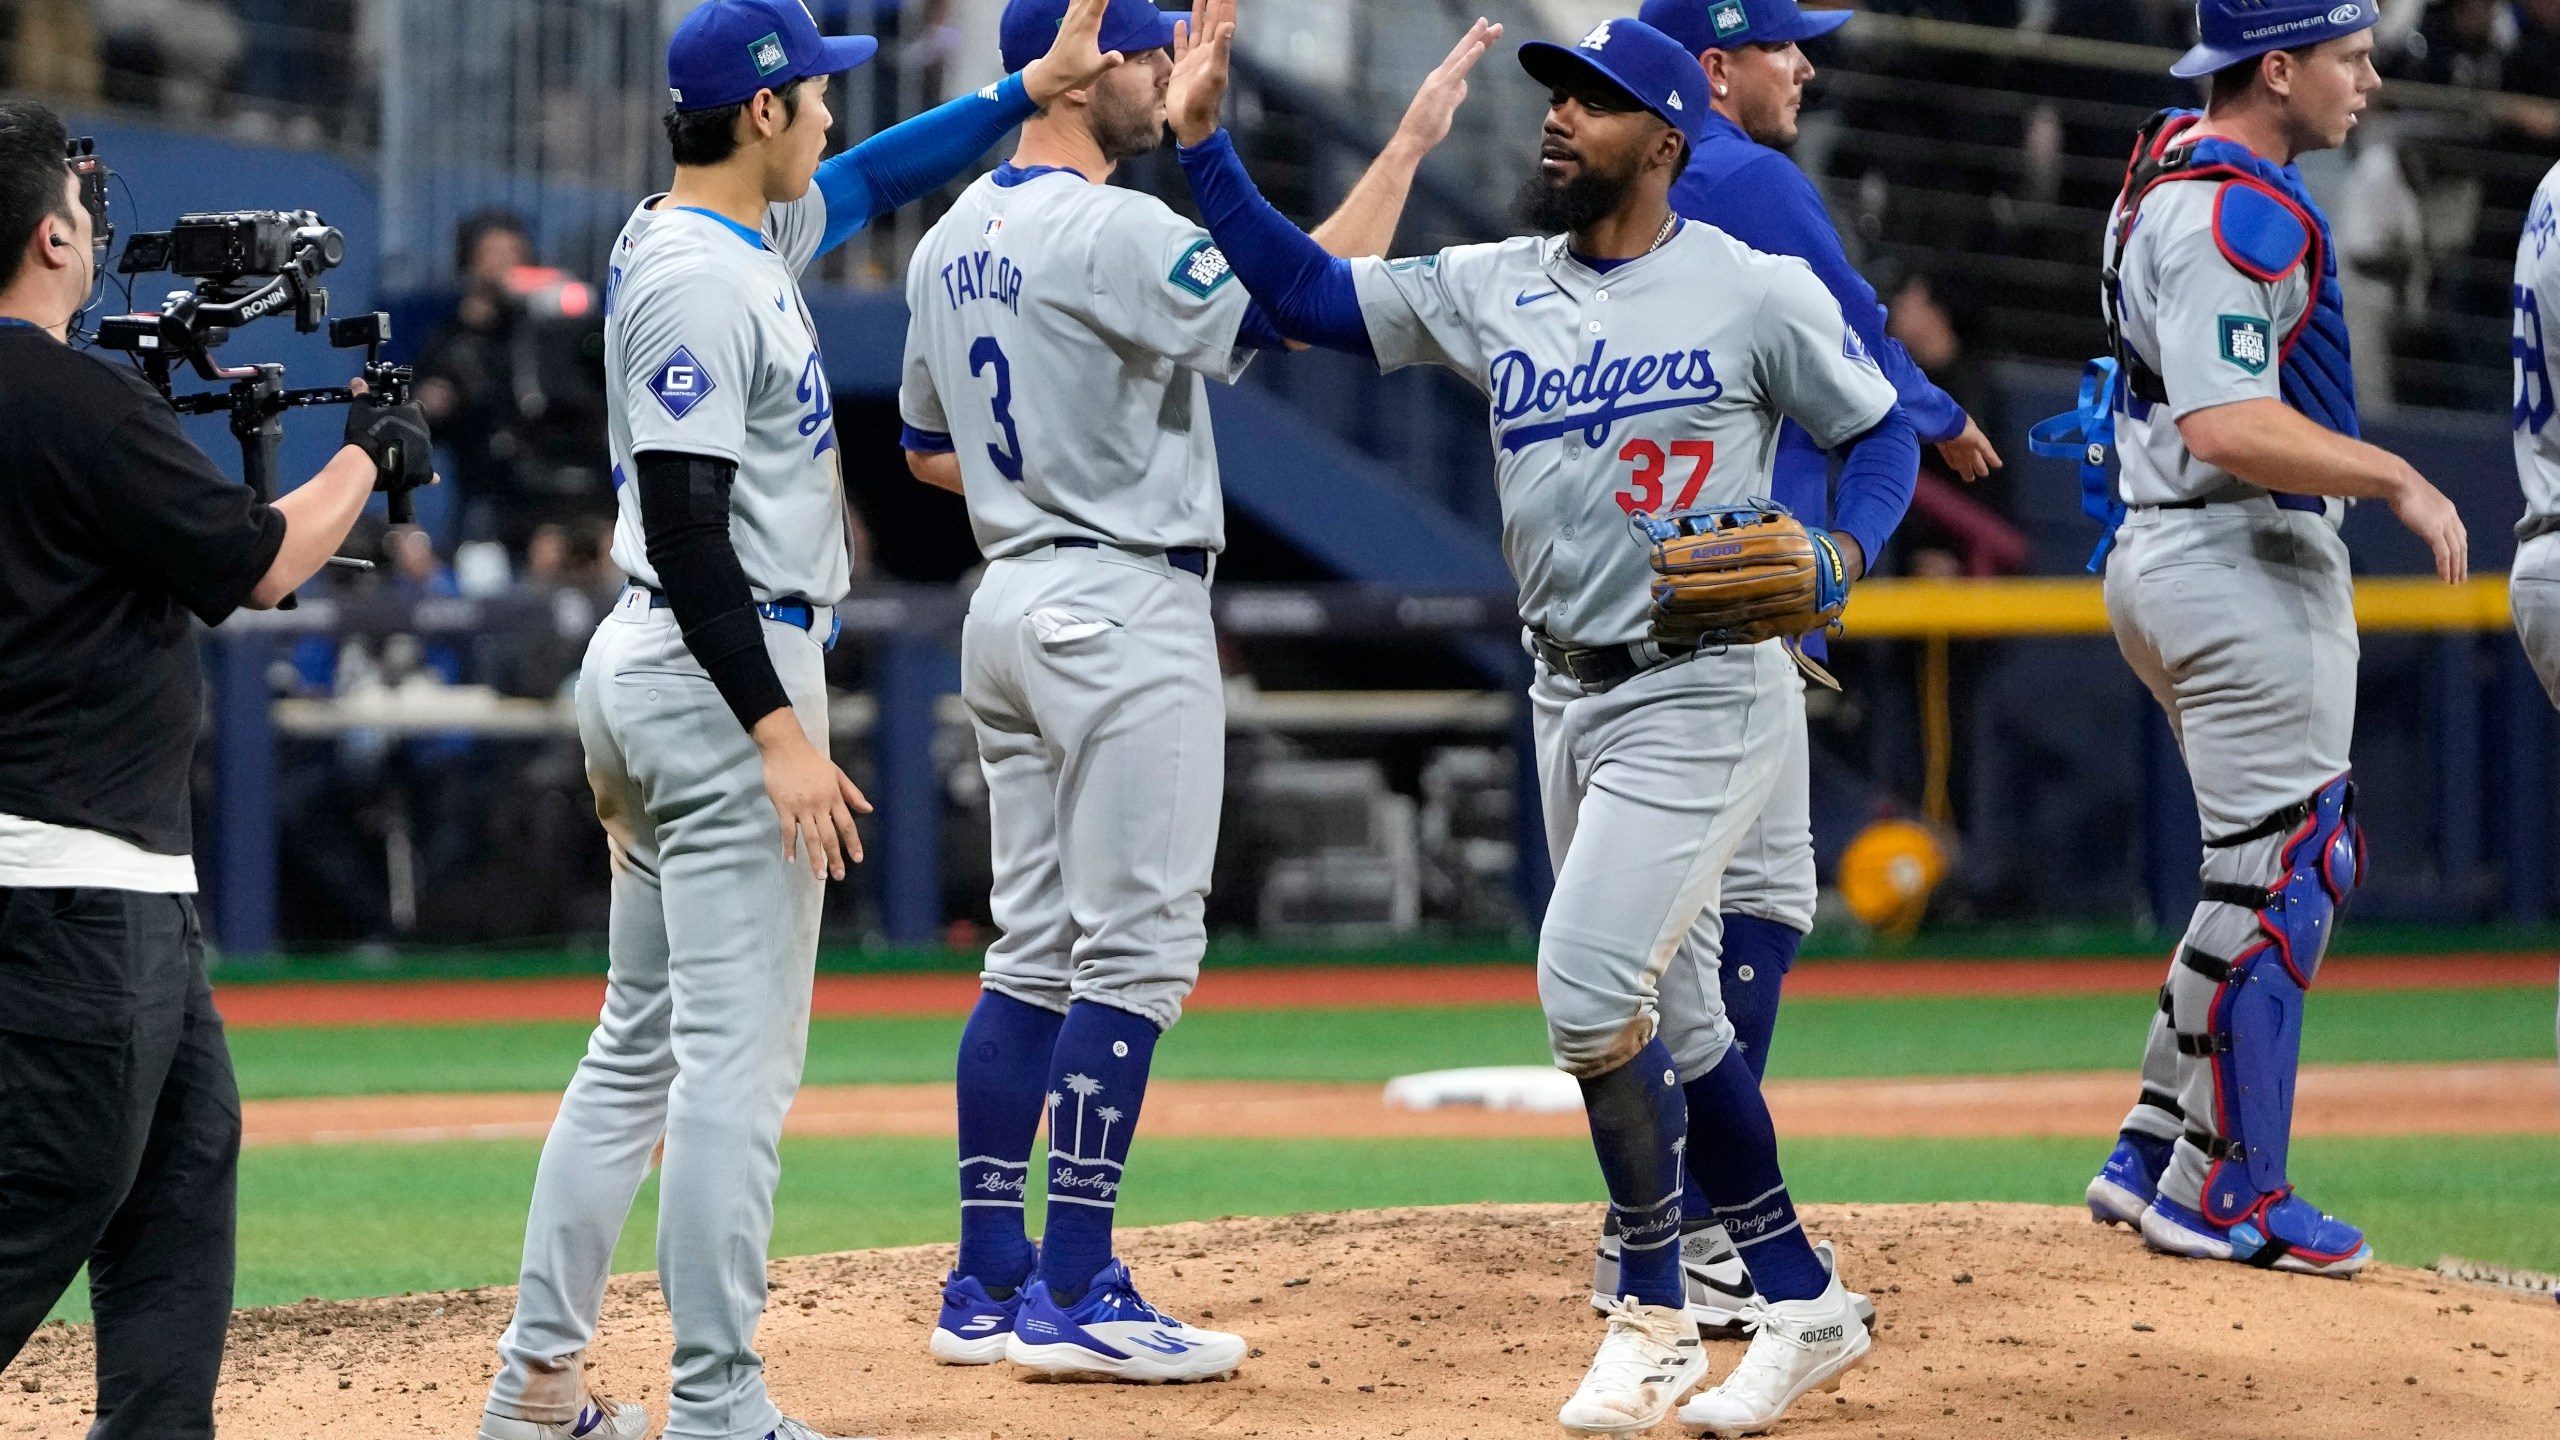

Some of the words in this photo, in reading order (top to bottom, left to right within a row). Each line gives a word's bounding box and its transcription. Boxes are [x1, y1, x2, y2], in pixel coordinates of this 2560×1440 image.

[2242, 15, 2325, 40] GUGGENHEIM
[941, 251, 1022, 316] TAYLOR
[241, 287, 286, 320] RONIN
[2232, 334, 2263, 350] SEOUL
[2232, 345, 2265, 363] SERIES
[666, 366, 694, 389] G
[1490, 339, 1723, 449] Dodgers
[969, 337, 1024, 482] 3
[1615, 437, 1714, 516] 37
[1690, 543, 1743, 560] A2000
[975, 1171, 1006, 1192] Los
[1051, 1167, 1079, 1188] Los
[1724, 1206, 1784, 1233] Dodgers
[1799, 1324, 1844, 1343] ADIZERO
